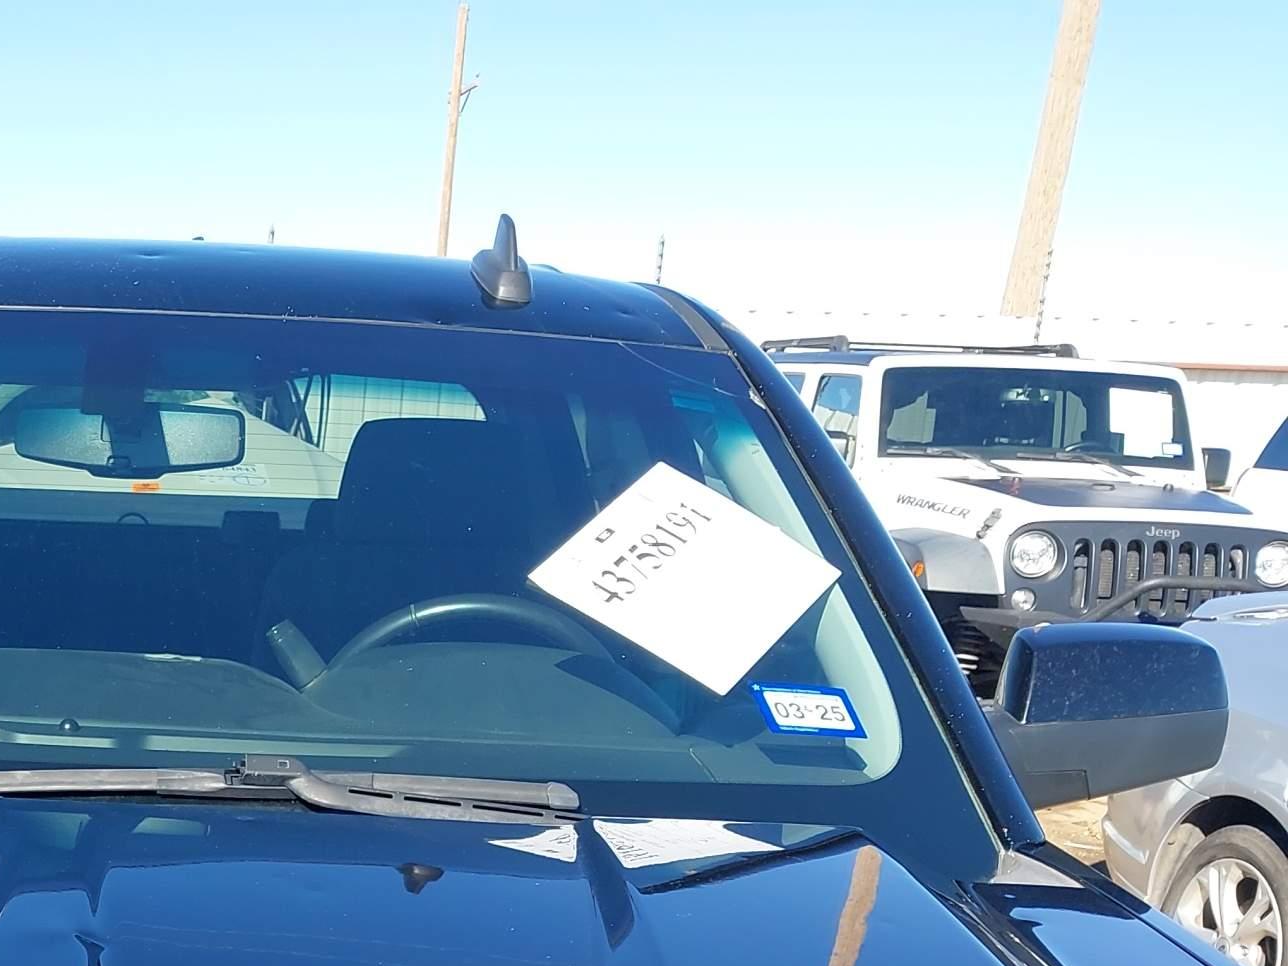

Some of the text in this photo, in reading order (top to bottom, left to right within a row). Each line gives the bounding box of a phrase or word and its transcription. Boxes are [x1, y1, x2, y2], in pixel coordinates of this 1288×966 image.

[896, 493, 971, 519] WRANGLER
[1145, 525, 1181, 540] Jeep
[592, 502, 712, 603] 43758191
